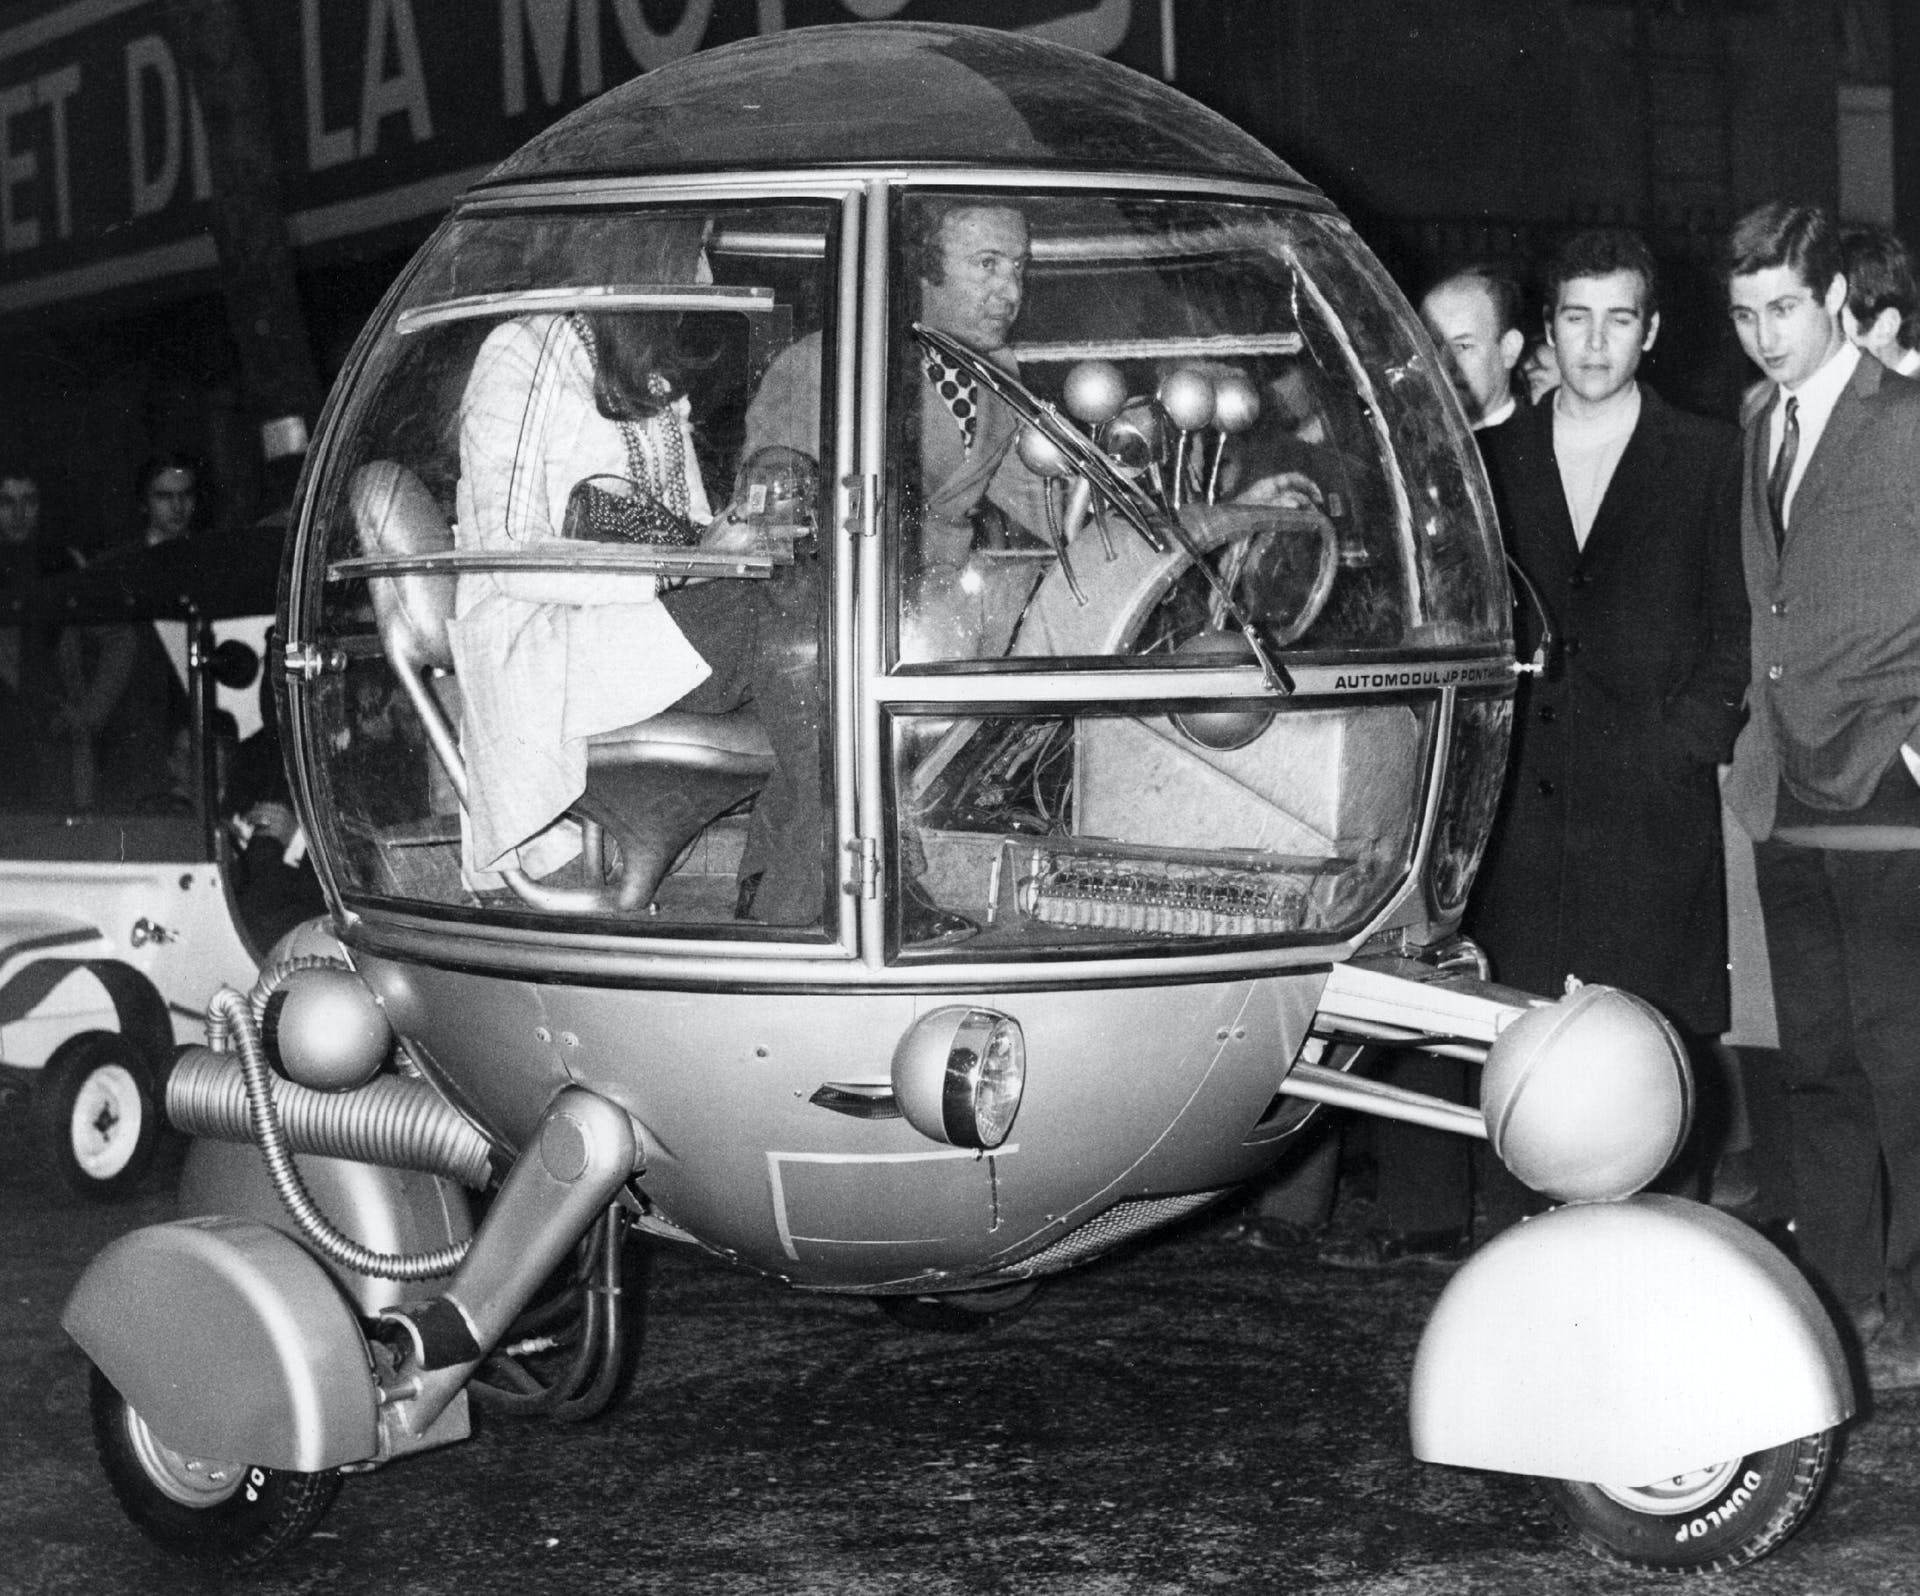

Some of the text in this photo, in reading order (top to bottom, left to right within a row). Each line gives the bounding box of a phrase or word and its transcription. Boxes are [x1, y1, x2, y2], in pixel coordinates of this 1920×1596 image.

[125, 35, 213, 217] D
[301, 0, 434, 171] LA
[1335, 673, 1440, 689] AUTOMODUL
[1675, 1470, 1762, 1543] DUNLOP
